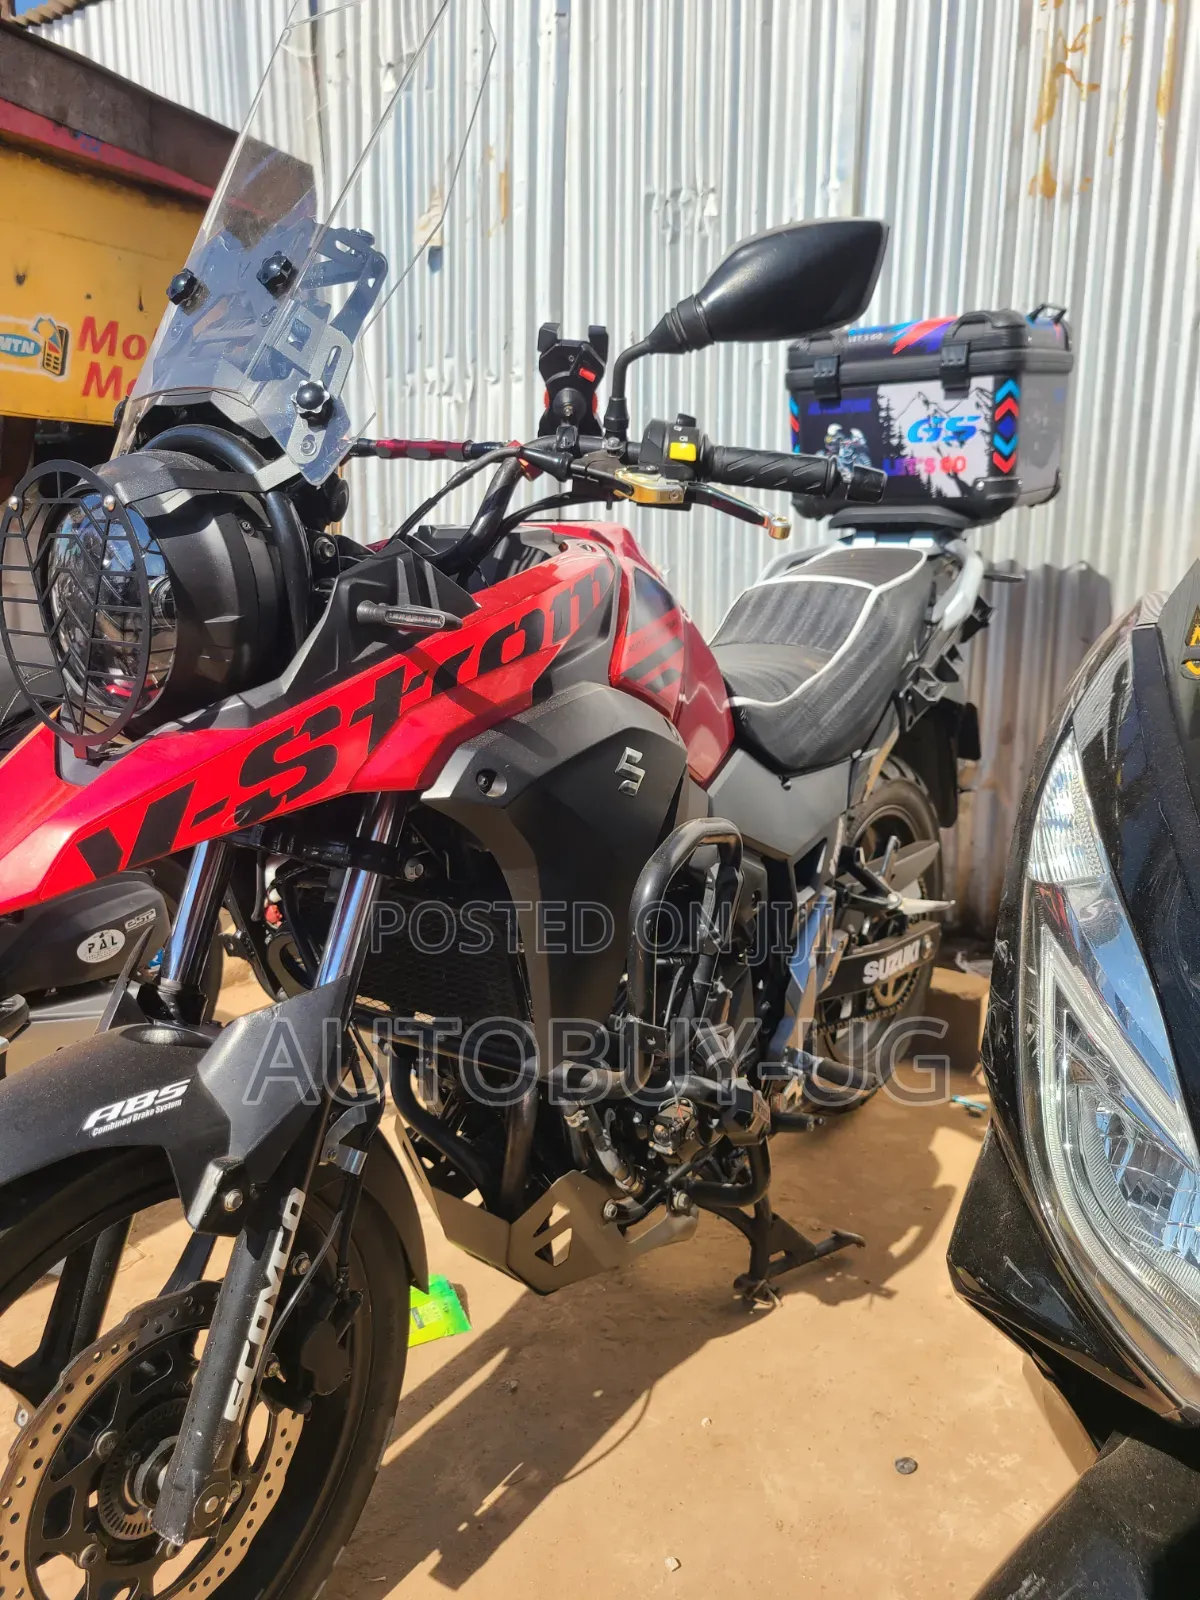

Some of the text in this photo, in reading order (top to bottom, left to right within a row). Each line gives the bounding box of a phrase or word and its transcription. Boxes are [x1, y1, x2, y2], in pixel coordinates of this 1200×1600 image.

[907, 415, 982, 444] GS
[862, 939, 922, 985] SUZUKI
[82, 1078, 191, 1131] ABS
[91, 1099, 183, 1138] Combined Brake System
